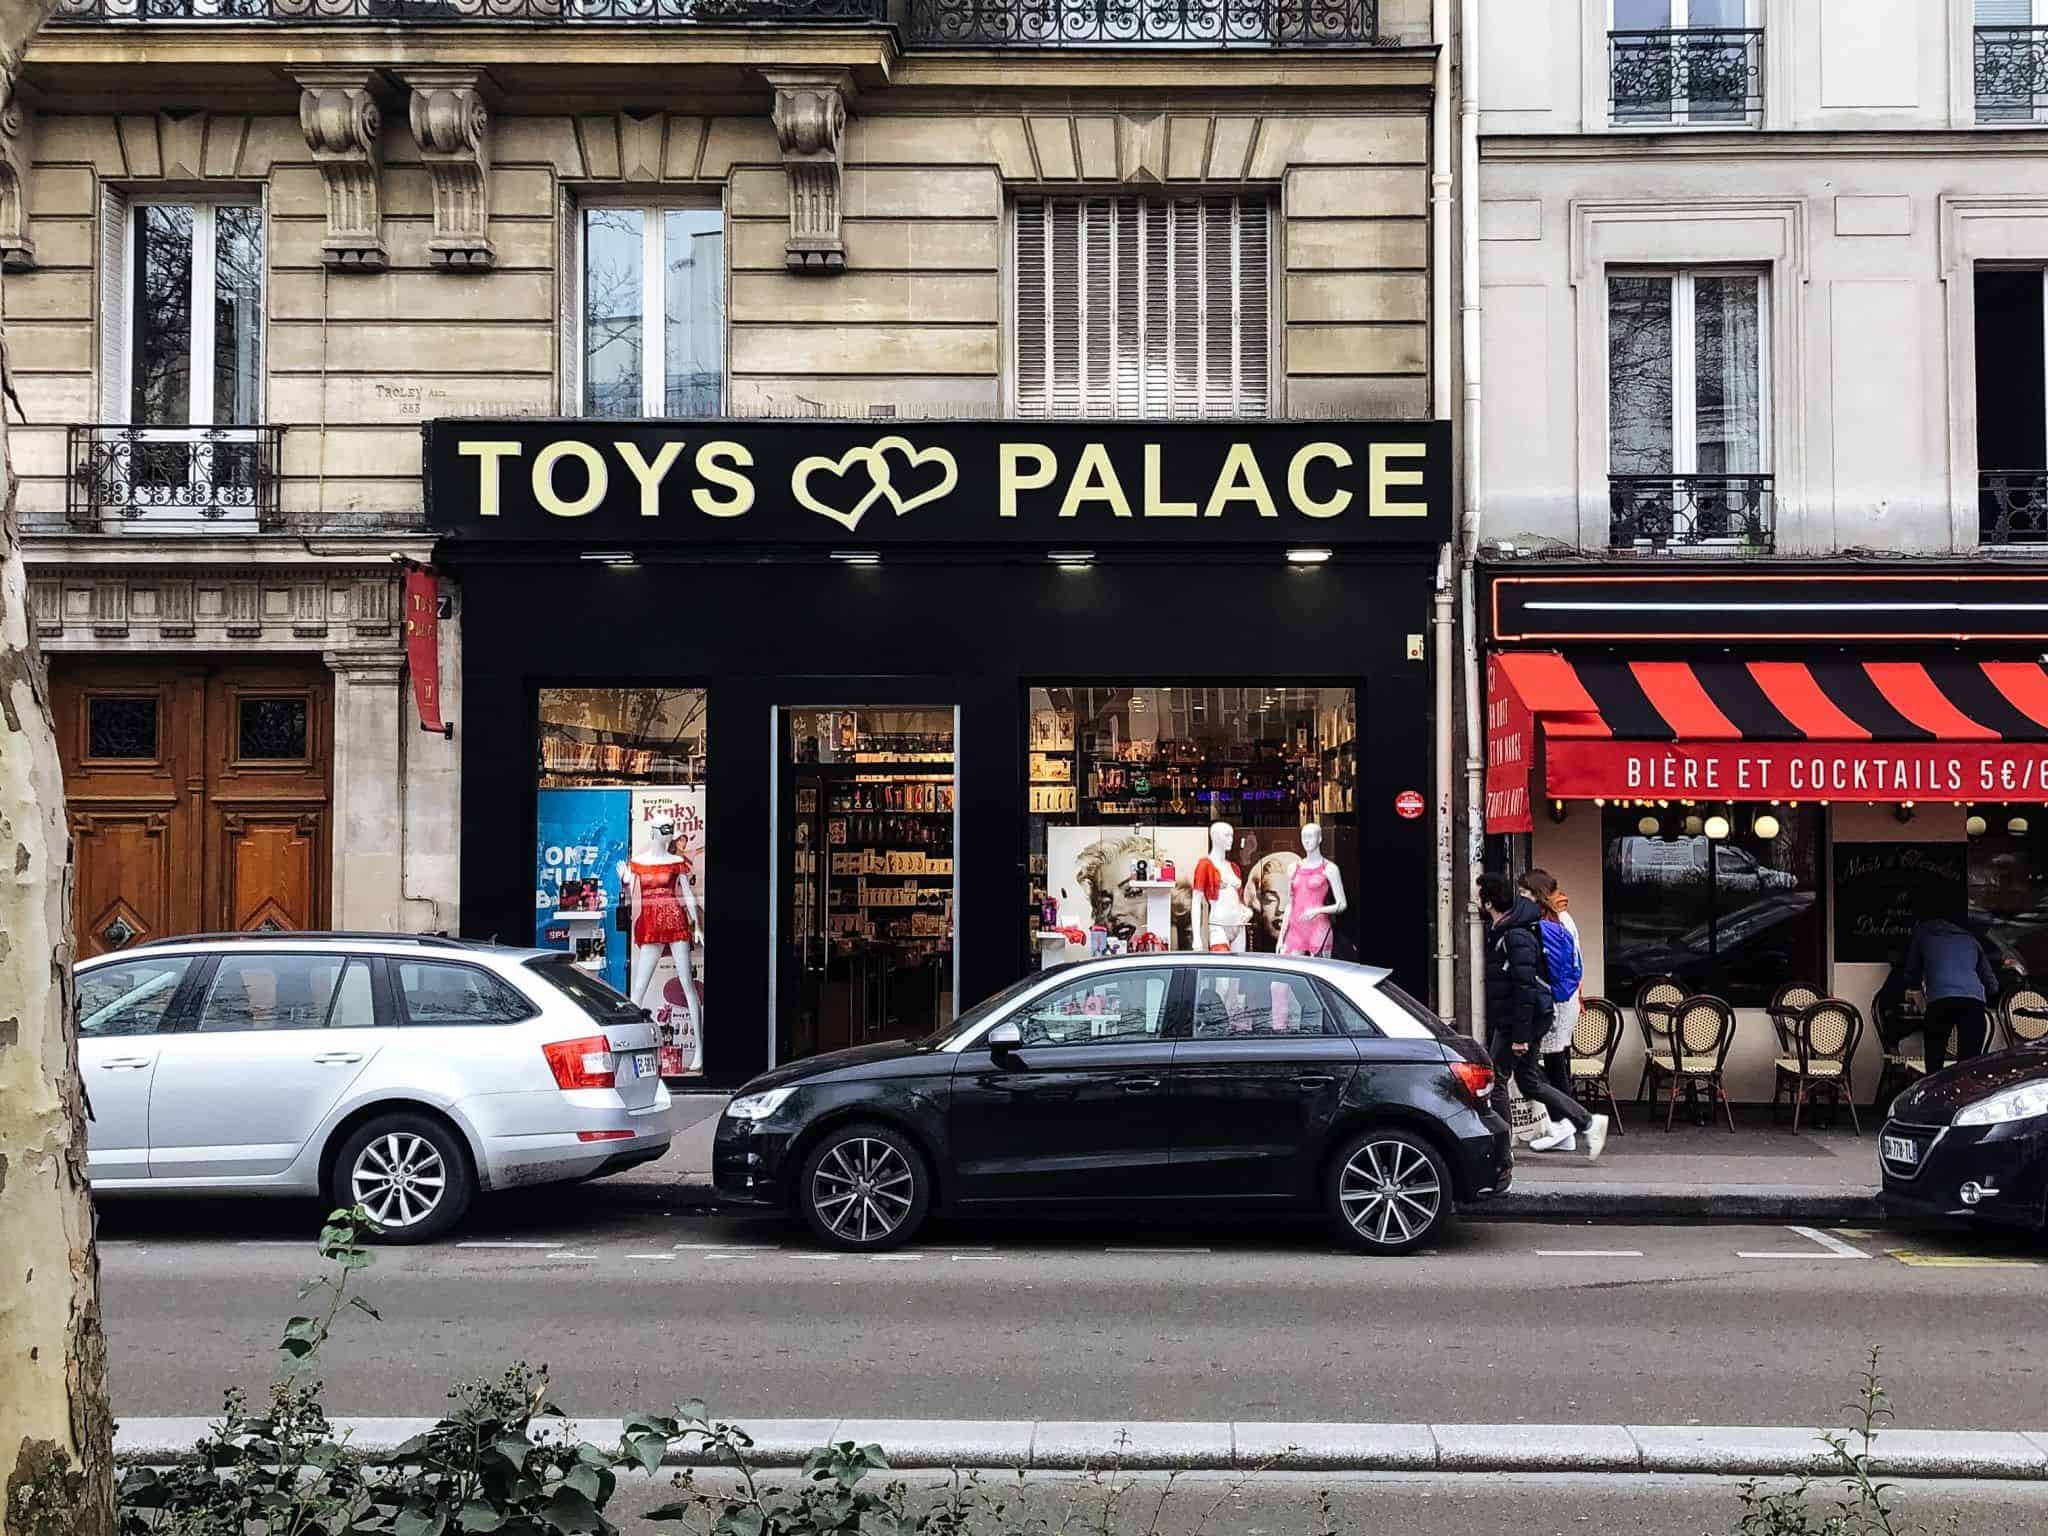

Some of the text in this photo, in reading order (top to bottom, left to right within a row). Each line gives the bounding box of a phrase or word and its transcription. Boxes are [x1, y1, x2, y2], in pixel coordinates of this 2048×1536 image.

[458, 440, 1428, 518] TOYS PALACE
[1627, 752, 1719, 788] BIÈRE
[1738, 759, 1772, 788] ET
[1790, 759, 1961, 789] COCKTAILS
